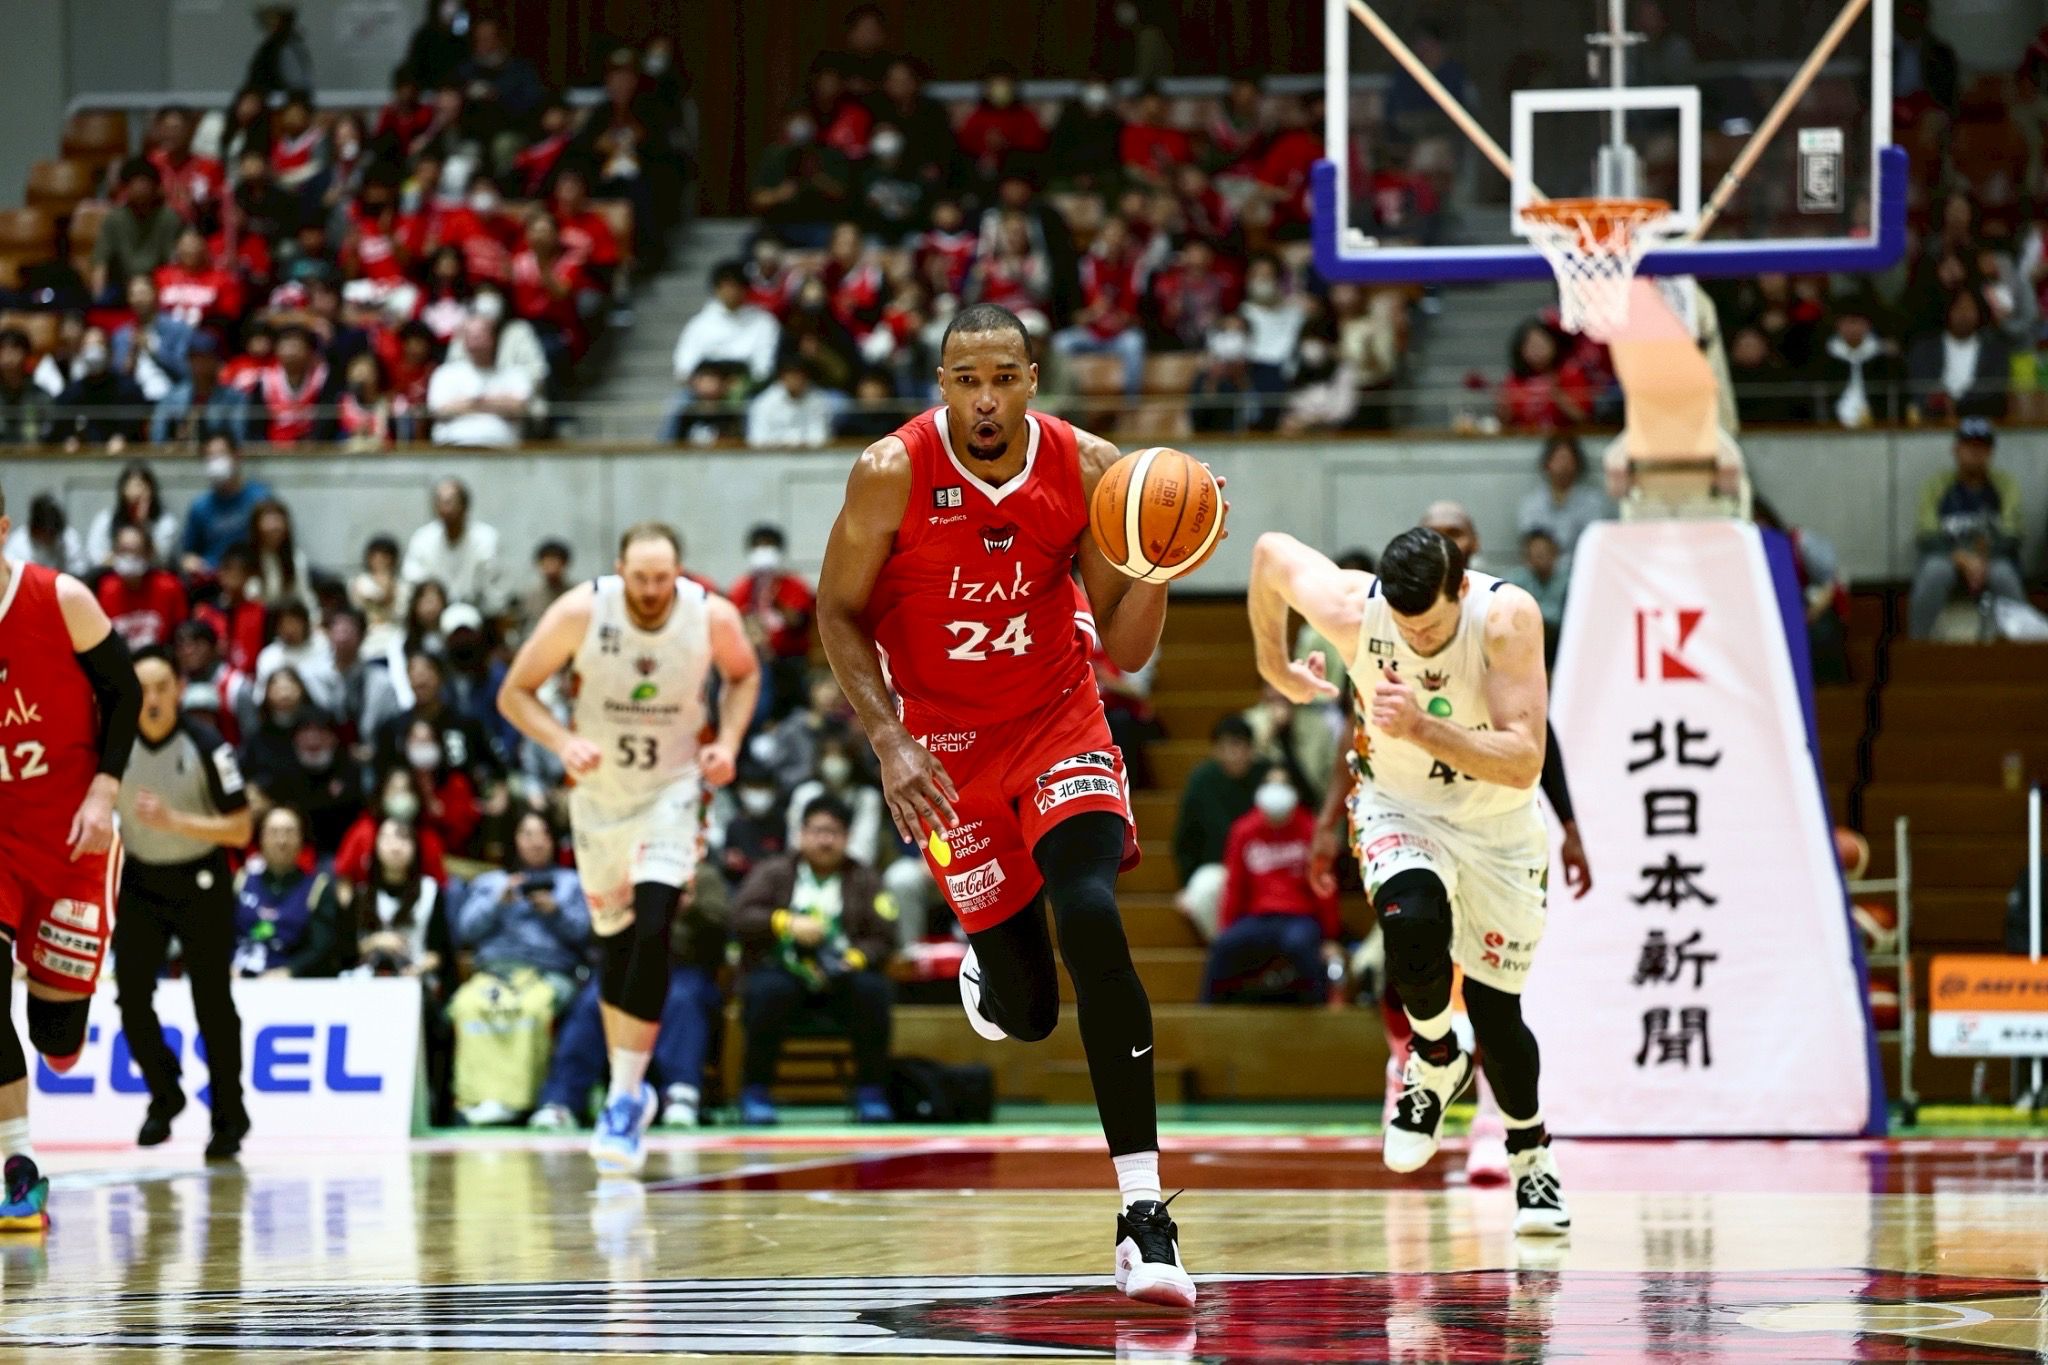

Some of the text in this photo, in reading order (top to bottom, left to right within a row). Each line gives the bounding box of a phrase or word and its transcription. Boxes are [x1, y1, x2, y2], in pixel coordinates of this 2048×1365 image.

[1162, 480, 1178, 508] FIBA
[1190, 477, 1211, 534] molten
[943, 611, 1035, 661] 24
[0, 740, 49, 781] 12
[616, 734, 658, 770] 53
[1058, 778, 1119, 798] 北陸銀行
[1428, 759, 1477, 786] 4
[948, 820, 983, 839] SUNNY
[951, 833, 976, 849] LIVE
[954, 836, 991, 859] GROUP
[1627, 718, 1722, 1070] 北日本新聞
[36, 1024, 383, 1094] COEL
